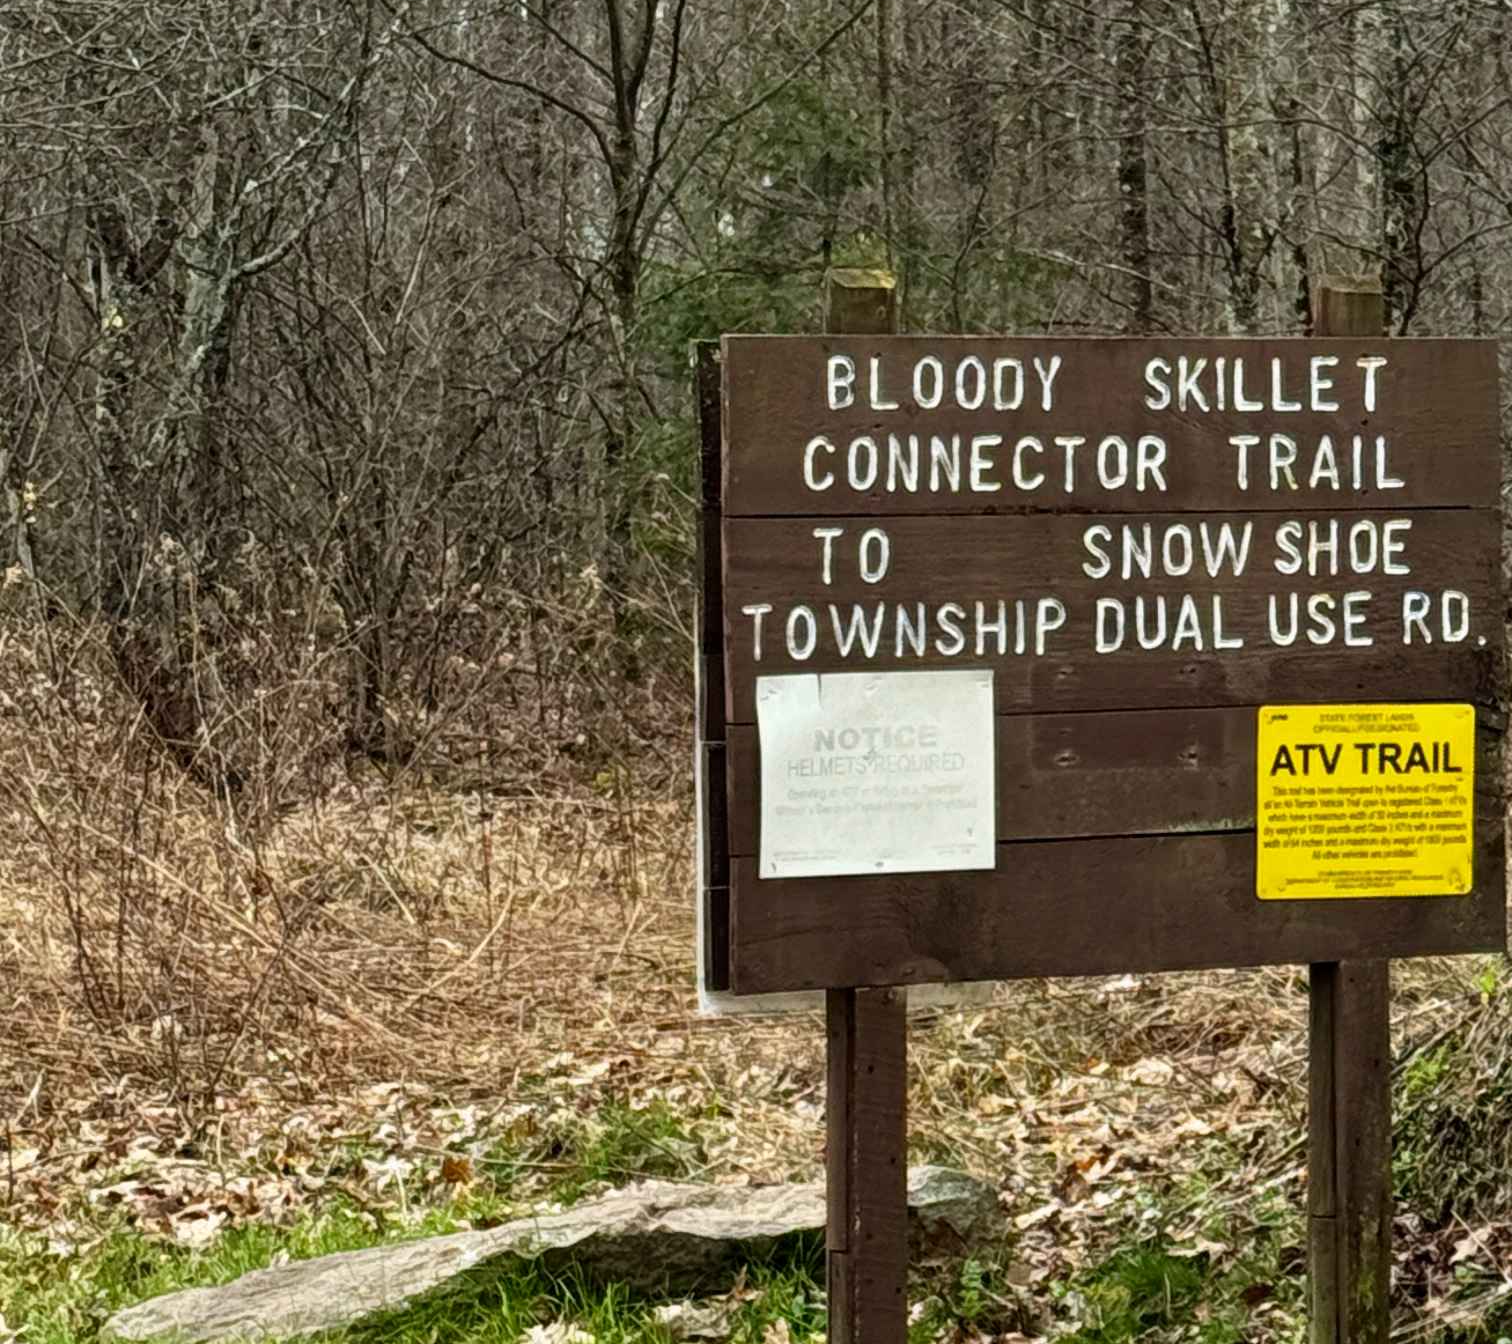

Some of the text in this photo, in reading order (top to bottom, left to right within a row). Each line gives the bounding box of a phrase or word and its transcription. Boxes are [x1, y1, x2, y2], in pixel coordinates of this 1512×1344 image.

[827, 355, 1388, 413] BLOODY SKILLET
[803, 433, 1405, 493] CONNECTOR TRAIL
[813, 519, 1412, 585] TO SNOW SHOE
[742, 590, 1487, 660] TOWNSHIP DUAL USE RD.
[787, 752, 966, 777] HELMETS REQUIRED
[815, 726, 938, 752] NOTICE
[1270, 741, 1462, 776] ATV TRAIL
